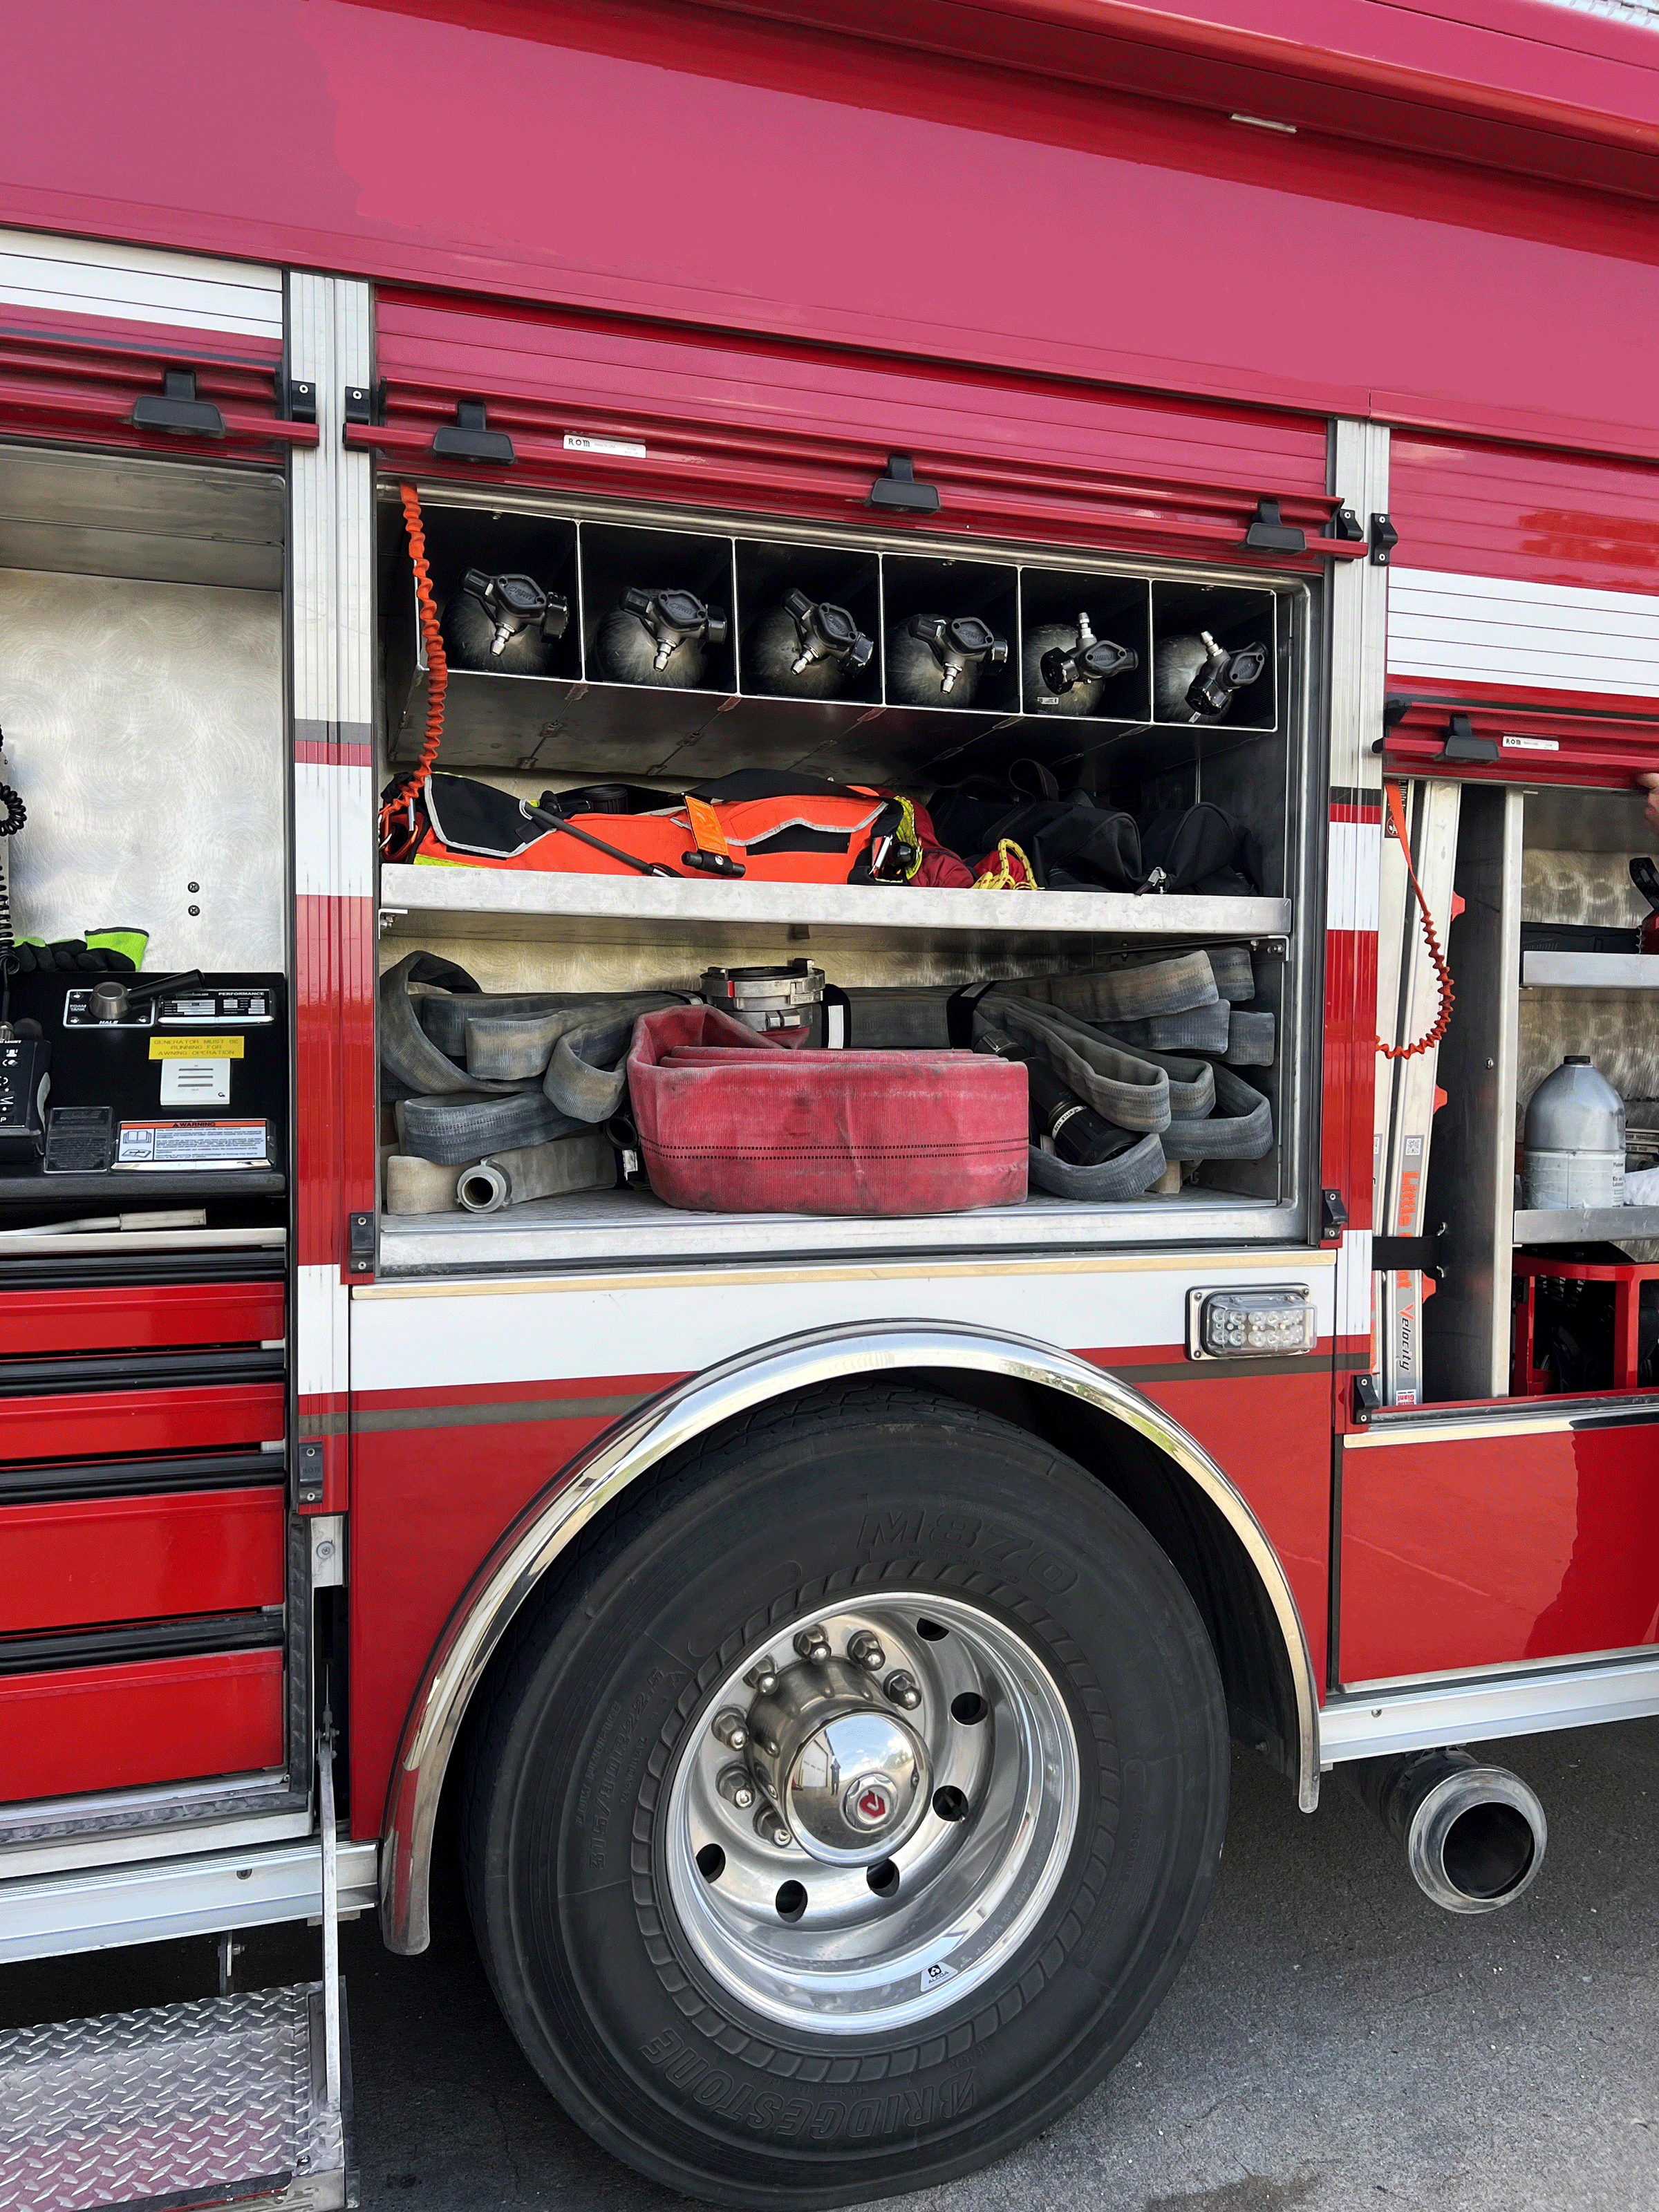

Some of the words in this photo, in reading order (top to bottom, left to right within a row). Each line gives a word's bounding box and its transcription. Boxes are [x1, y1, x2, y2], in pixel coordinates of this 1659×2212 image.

[568, 438, 590, 447] ROM
[1398, 1170, 1419, 1226] Little
[1398, 1302, 1415, 1371] Velocity
[1397, 1393, 1414, 1401] Giant
[857, 1508, 1078, 1595] M870
[590, 1666, 666, 1871] 315/80R22.5
[928, 1971, 949, 1983] ALCOA
[637, 2027, 977, 2140] BRIDGESTONE
